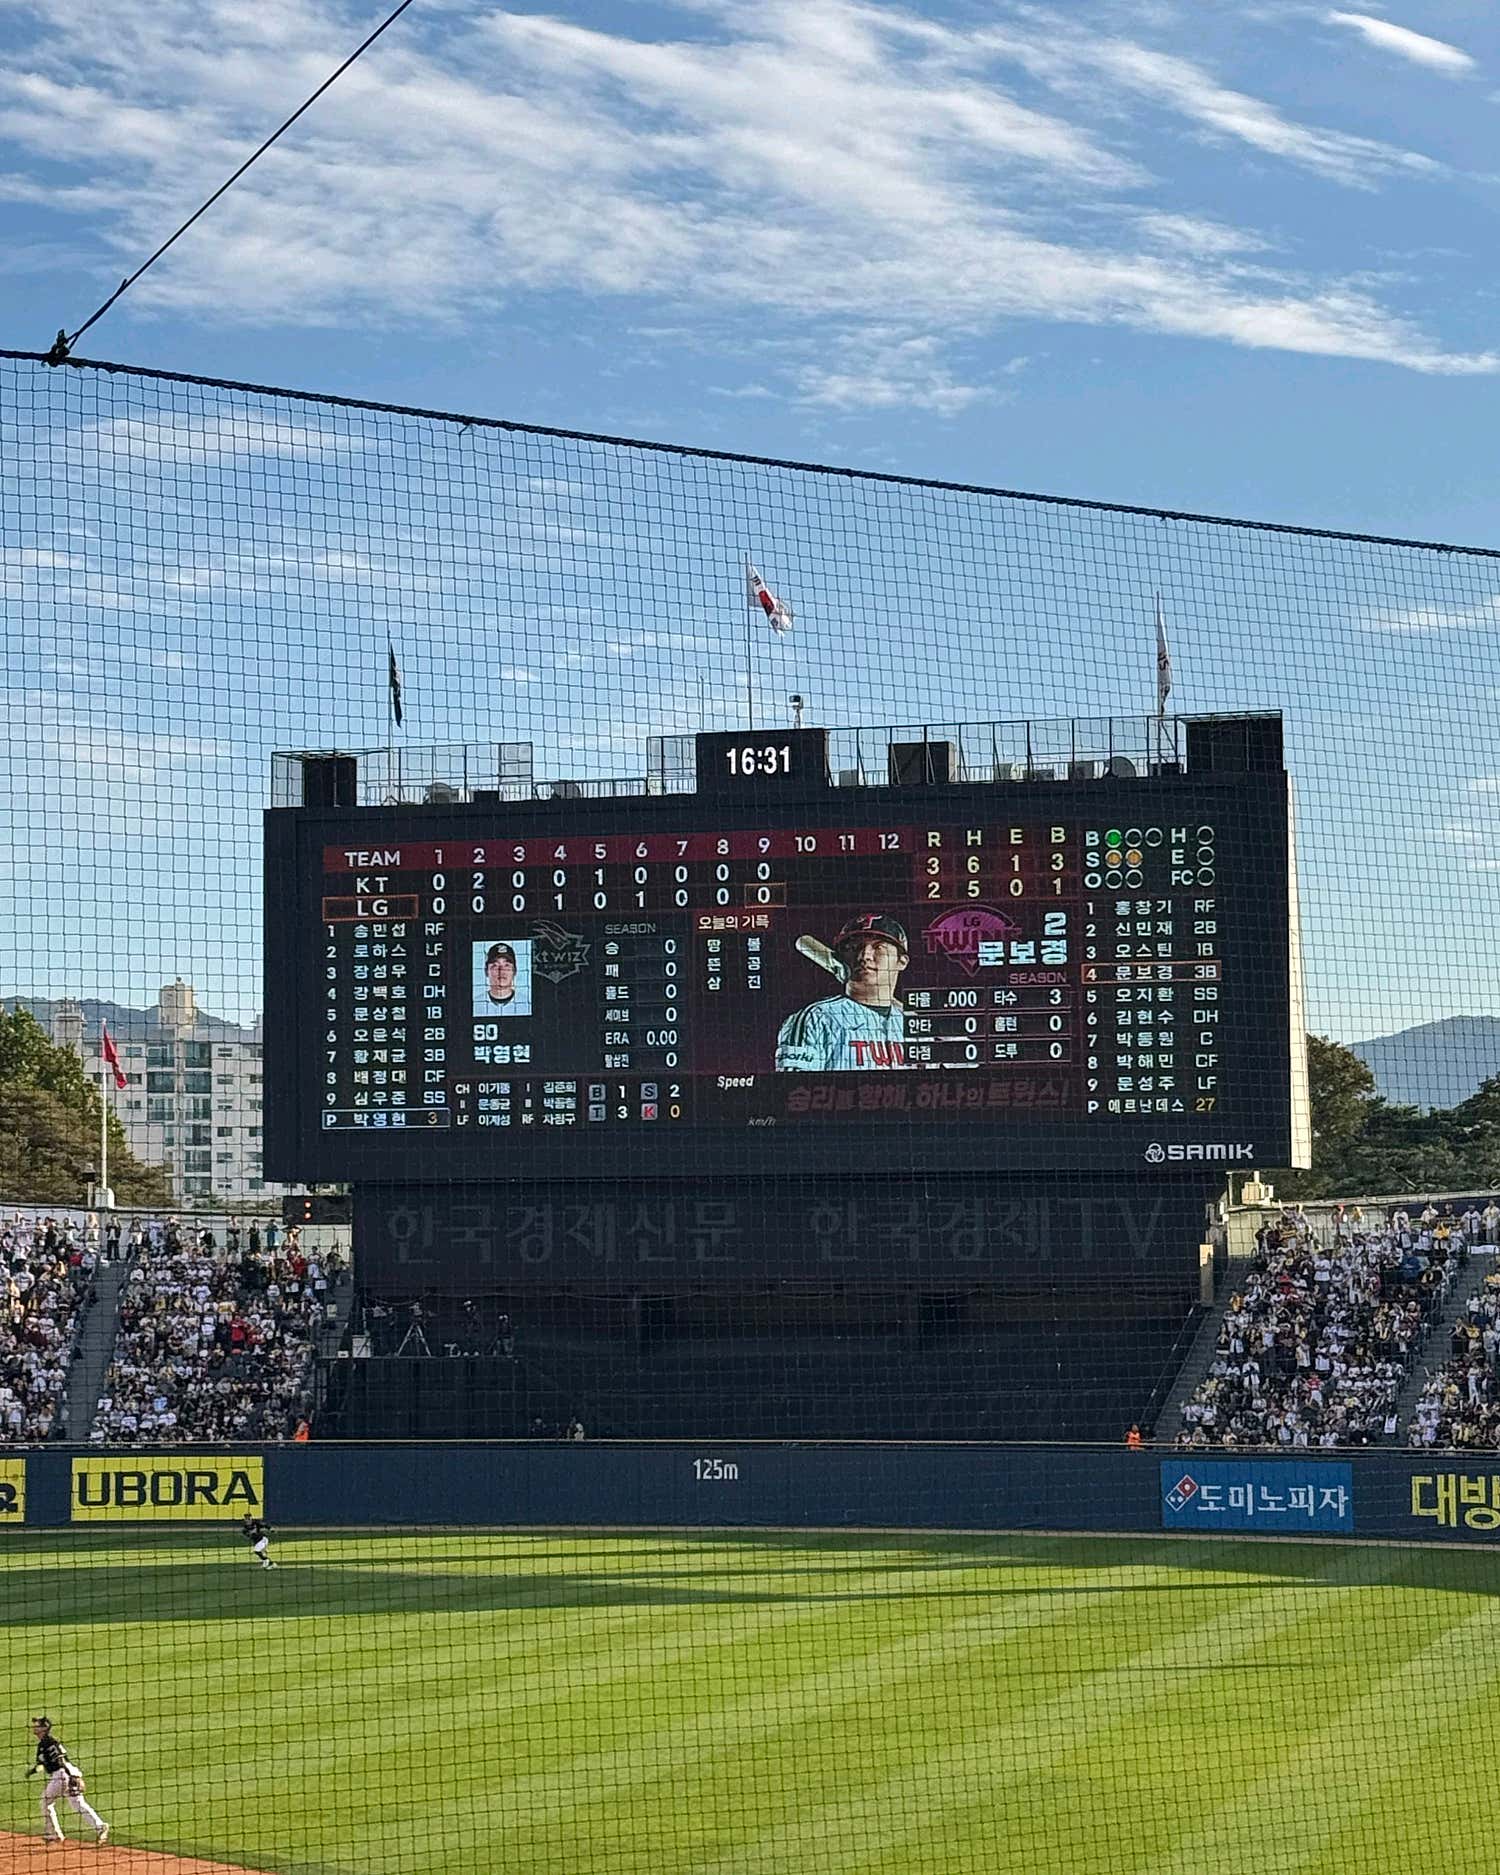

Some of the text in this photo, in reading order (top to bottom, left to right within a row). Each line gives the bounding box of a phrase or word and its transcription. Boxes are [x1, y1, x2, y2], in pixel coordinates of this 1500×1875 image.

[727, 746, 789, 774] 16:31
[1086, 828, 1186, 846] B H
[345, 827, 1065, 867] TEAM 2 3 4 5 6 7 8 9 10 11 12 R H E B
[1086, 849, 1184, 867] S E
[433, 874, 445, 890] 0
[473, 873, 484, 889] 2
[513, 871, 524, 888] 0
[554, 870, 565, 886] 0
[635, 867, 647, 884] 0
[676, 866, 687, 882] 0
[717, 864, 729, 881] 0
[758, 863, 769, 880] 0
[927, 858, 939, 874] 3
[968, 856, 979, 873] 6
[1052, 853, 1063, 870] 3
[1085, 870, 1193, 888] O FC
[357, 879, 1023, 916] LG 0 0 0 0 0 0 0 2 5 0
[1195, 900, 1215, 912] RF
[425, 923, 444, 935] RF
[605, 923, 655, 934] SEASON
[699, 915, 769, 929] 오늘의 기록
[1045, 912, 1066, 935] 2
[1086, 924, 1096, 936] 2
[1194, 921, 1216, 934] 2B
[327, 946, 336, 958] 2
[426, 943, 442, 955] LF
[605, 940, 676, 954] 승 0
[978, 939, 1067, 966] 문보경
[1087, 946, 1096, 959] 3
[1197, 943, 1213, 956] 1B
[327, 967, 336, 979] 3
[429, 964, 440, 976] C
[605, 962, 676, 977] 패 0
[1086, 968, 1097, 979] 4
[1194, 965, 1217, 979] 3B
[1009, 972, 1066, 984] SEASON
[424, 985, 445, 998] DH
[666, 984, 676, 998] 0
[909, 989, 1061, 1007] 타율 .000 타수 3
[1087, 990, 1096, 1002] 5
[1194, 987, 1217, 1000] SS
[427, 1006, 441, 1019] 1B
[666, 1008, 677, 1021] 0
[1087, 1012, 1097, 1025] 6
[1194, 1010, 1218, 1023] DH
[909, 1019, 931, 1033] 안타
[965, 1017, 976, 1033] 0
[1050, 1016, 1061, 1031] 0
[327, 1030, 336, 1042] 6
[425, 1028, 445, 1040] 2B
[606, 1030, 677, 1045] ERA 0.00
[1088, 1034, 1097, 1047] 7
[1201, 1032, 1212, 1045] C
[327, 1051, 336, 1062] 7
[424, 1049, 445, 1061] 3B
[474, 1045, 530, 1063] 박영현
[909, 1043, 1062, 1060] 타점 0 도루 0
[666, 1052, 677, 1067] 0
[1088, 1056, 1097, 1069] 8
[1196, 1054, 1218, 1067] CF
[425, 1070, 445, 1082] CF
[717, 1075, 754, 1090] Speed
[1088, 1079, 1097, 1091] 9
[1198, 1076, 1216, 1089] LF
[327, 1093, 336, 1105] 9
[424, 1091, 445, 1103] SS
[670, 1085, 680, 1097] 2
[618, 1105, 680, 1118] 3 0
[1088, 1101, 1099, 1113] P
[1196, 1098, 1215, 1111] 27
[326, 1114, 338, 1126] P
[428, 1112, 437, 1125] 3
[1168, 1144, 1253, 1160] SAMIK
[386, 1201, 742, 1265] 한국경제신문
[693, 1459, 738, 1479] 125m
[78, 1471, 259, 1506] UBORA
[1197, 1483, 1349, 1517] 도미노피자
